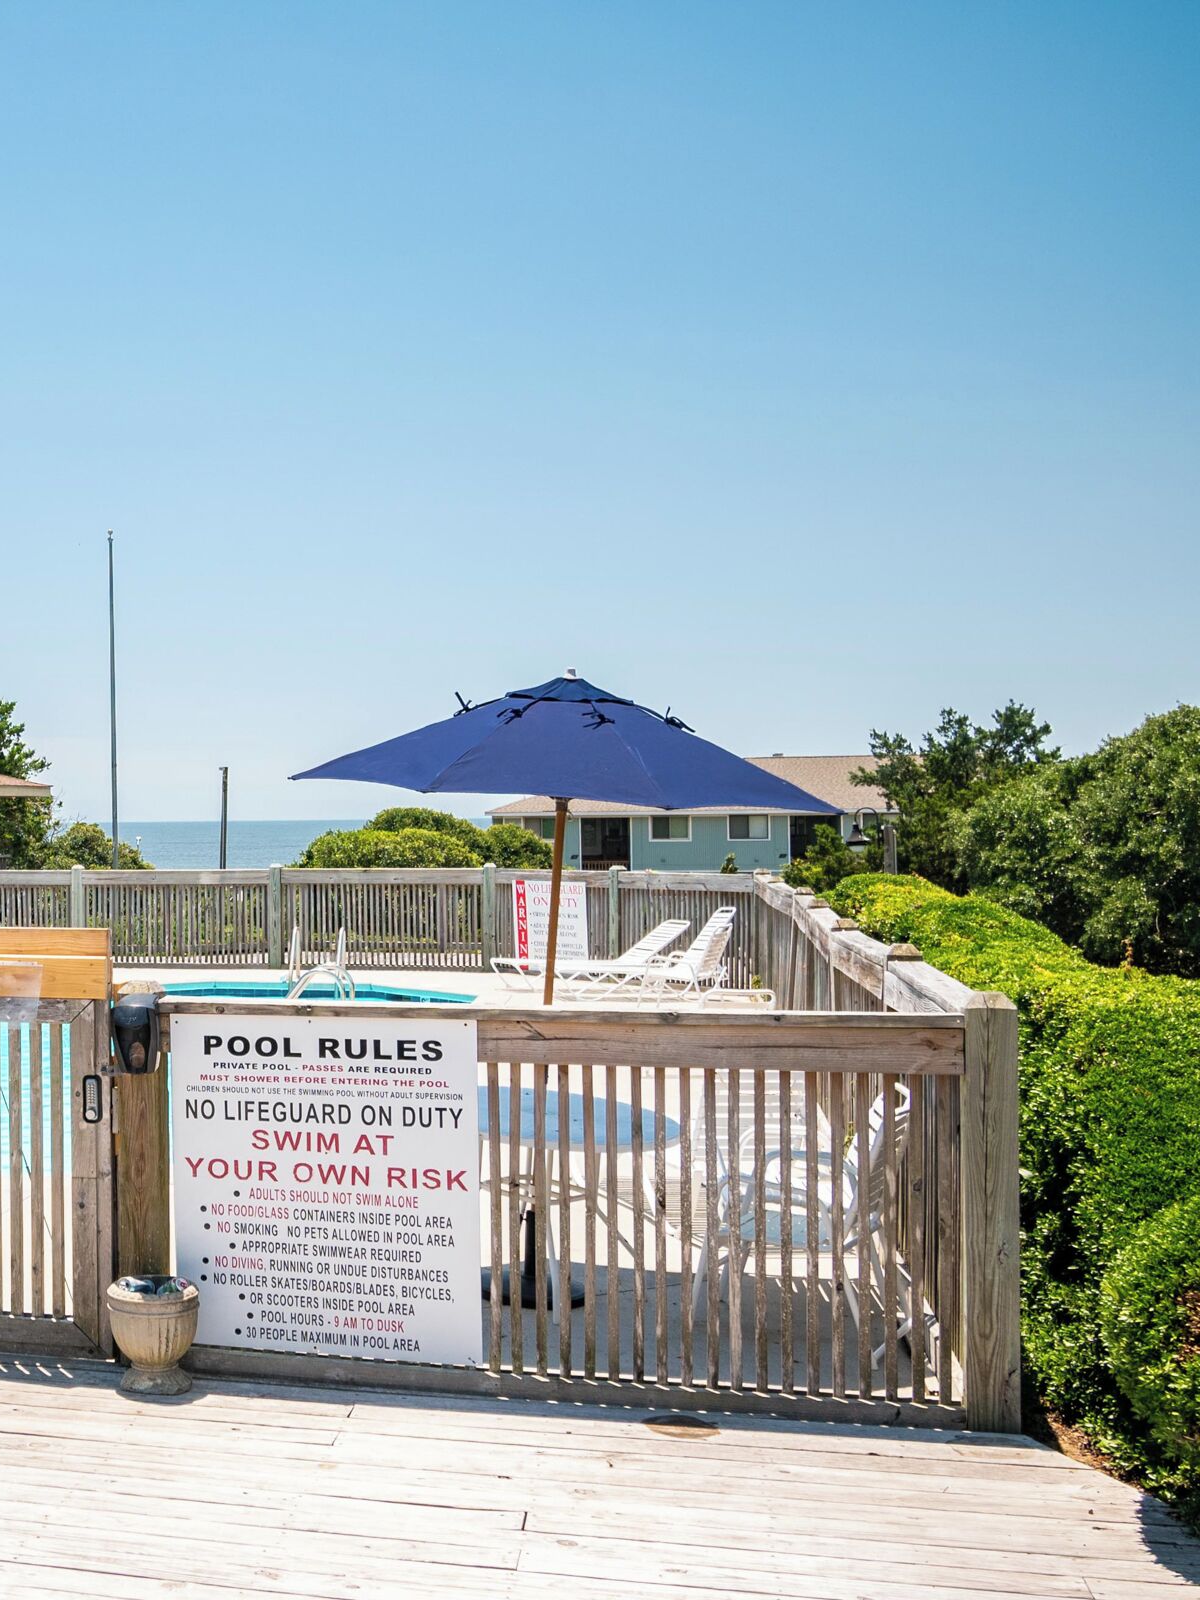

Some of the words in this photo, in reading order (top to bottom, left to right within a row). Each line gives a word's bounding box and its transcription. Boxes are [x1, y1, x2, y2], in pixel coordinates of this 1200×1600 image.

[528, 884, 539, 893] NO
[533, 896, 548, 906] ON
[516, 884, 528, 959] WARNIN
[204, 1036, 302, 1058] POOL
[319, 1038, 442, 1061] RULES
[214, 1062, 258, 1070] PRIVATE
[222, 1086, 249, 1094] SHOULD
[283, 1088, 296, 1096] THE
[299, 1088, 334, 1096] SWIMMING
[416, 1092, 462, 1100] SUPERVISION
[234, 1075, 279, 1083] SHOWER
[284, 1076, 326, 1084] BEFORE
[332, 1078, 388, 1086] ENTERING
[420, 1080, 449, 1088] POOL
[186, 1099, 215, 1119] NO
[224, 1100, 351, 1124] LIFEGUARD
[361, 1105, 391, 1126] ON
[403, 1106, 462, 1128] DUTY
[252, 1130, 339, 1153] SWIM
[353, 1134, 394, 1156] AT
[185, 1157, 278, 1182] YOUR
[293, 1163, 369, 1186] OWN
[387, 1168, 468, 1191] RISK
[249, 1188, 286, 1201] ADULTS
[290, 1190, 329, 1203] SHOULD
[333, 1192, 352, 1204] NOT
[356, 1193, 381, 1206] SWIM
[385, 1195, 418, 1208] ALONE
[212, 1204, 224, 1216] NO
[228, 1204, 289, 1220] FOOD/GLASS
[293, 1208, 355, 1224] CONTAINERS
[359, 1212, 390, 1226] INSIDE
[395, 1214, 422, 1227] POOL
[425, 1216, 452, 1229] AREA
[218, 1221, 230, 1233] NO
[234, 1222, 278, 1236] SMOKING
[288, 1226, 300, 1238] NO
[304, 1226, 328, 1240] PETS
[332, 1228, 380, 1242] ALLOWED
[384, 1232, 392, 1243] IN
[396, 1232, 424, 1246] POOL
[427, 1234, 454, 1247] AREA
[242, 1240, 308, 1256] APPROPRIATE
[312, 1245, 367, 1260] SWIMWEAR
[371, 1248, 421, 1263] REQUIRED
[215, 1256, 228, 1268] NO
[232, 1256, 266, 1272] DIVING,
[270, 1259, 313, 1274] RUNNING
[317, 1262, 330, 1275] OR
[334, 1264, 367, 1277] UNDUE
[371, 1266, 448, 1283] DISTURBANCES
[214, 1272, 226, 1284] NO
[230, 1274, 268, 1288] ROLLER
[271, 1275, 399, 1299] SKATES/BOARDS/BLADES,
[402, 1286, 454, 1304] BICYCLES,
[250, 1292, 263, 1304] OR
[267, 1293, 319, 1309] SCOOTERS
[322, 1298, 354, 1311] INSIDE
[358, 1300, 384, 1314] POOL
[388, 1302, 415, 1316] AREA
[261, 1310, 287, 1324] POOL
[290, 1312, 324, 1326] HOURS
[334, 1316, 339, 1327] 9
[343, 1317, 357, 1328] AM
[361, 1318, 373, 1330] TO
[377, 1319, 404, 1333] DUSK
[247, 1326, 256, 1338] 30
[260, 1328, 297, 1342] PEOPLE
[301, 1330, 346, 1346] MAXIMUM
[350, 1335, 359, 1347] IN
[363, 1336, 390, 1350] POOL
[393, 1338, 420, 1352] AREA
